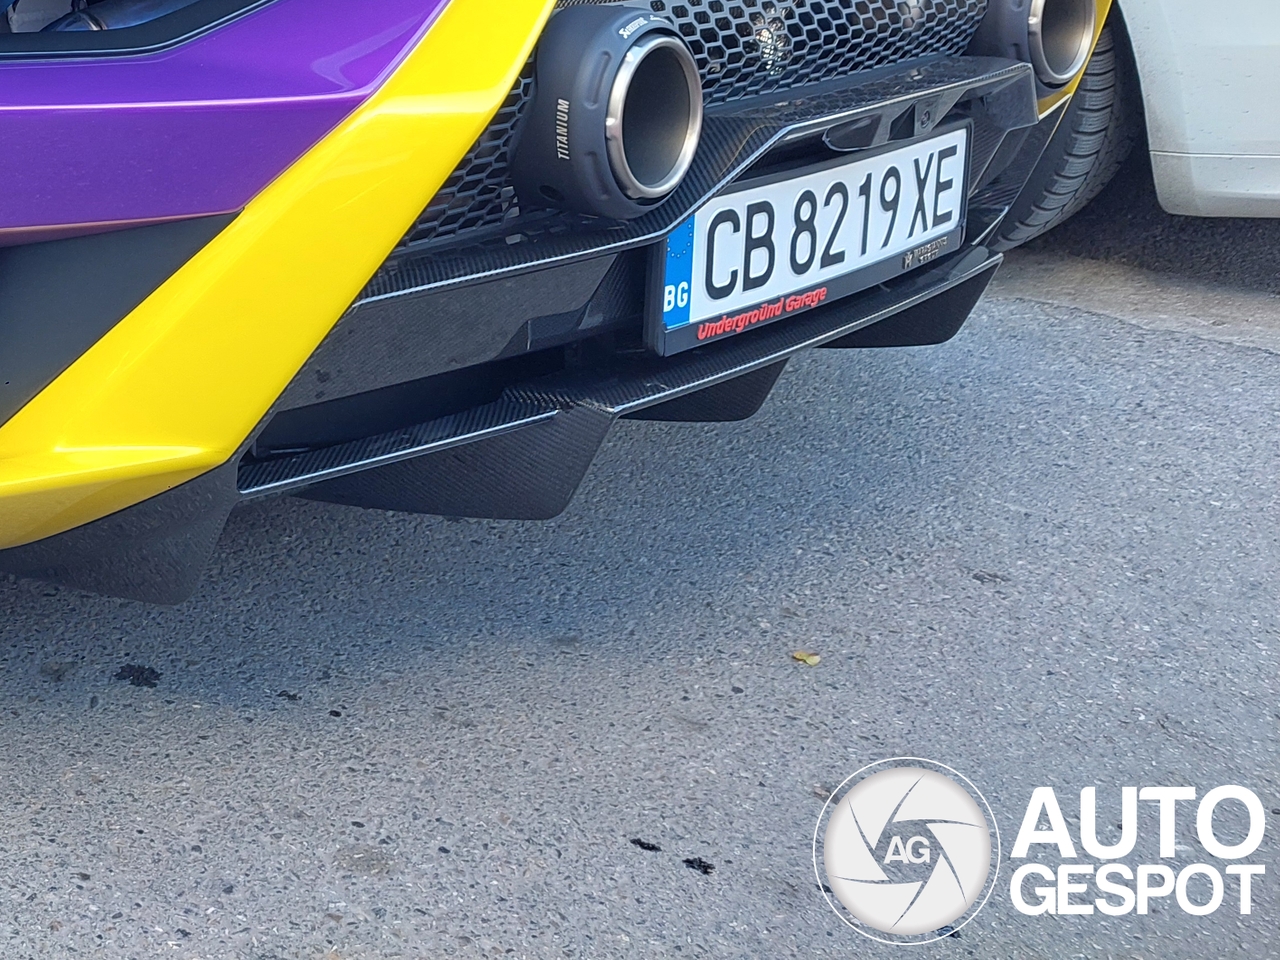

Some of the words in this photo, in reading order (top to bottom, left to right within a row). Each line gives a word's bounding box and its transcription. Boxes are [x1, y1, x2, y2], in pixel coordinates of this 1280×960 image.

[556, 98, 570, 161] TITANIUM
[704, 200, 776, 300] CB
[789, 165, 902, 276] 8219
[907, 144, 958, 239] XE
[664, 281, 689, 313] BG
[785, 287, 827, 313] Garage
